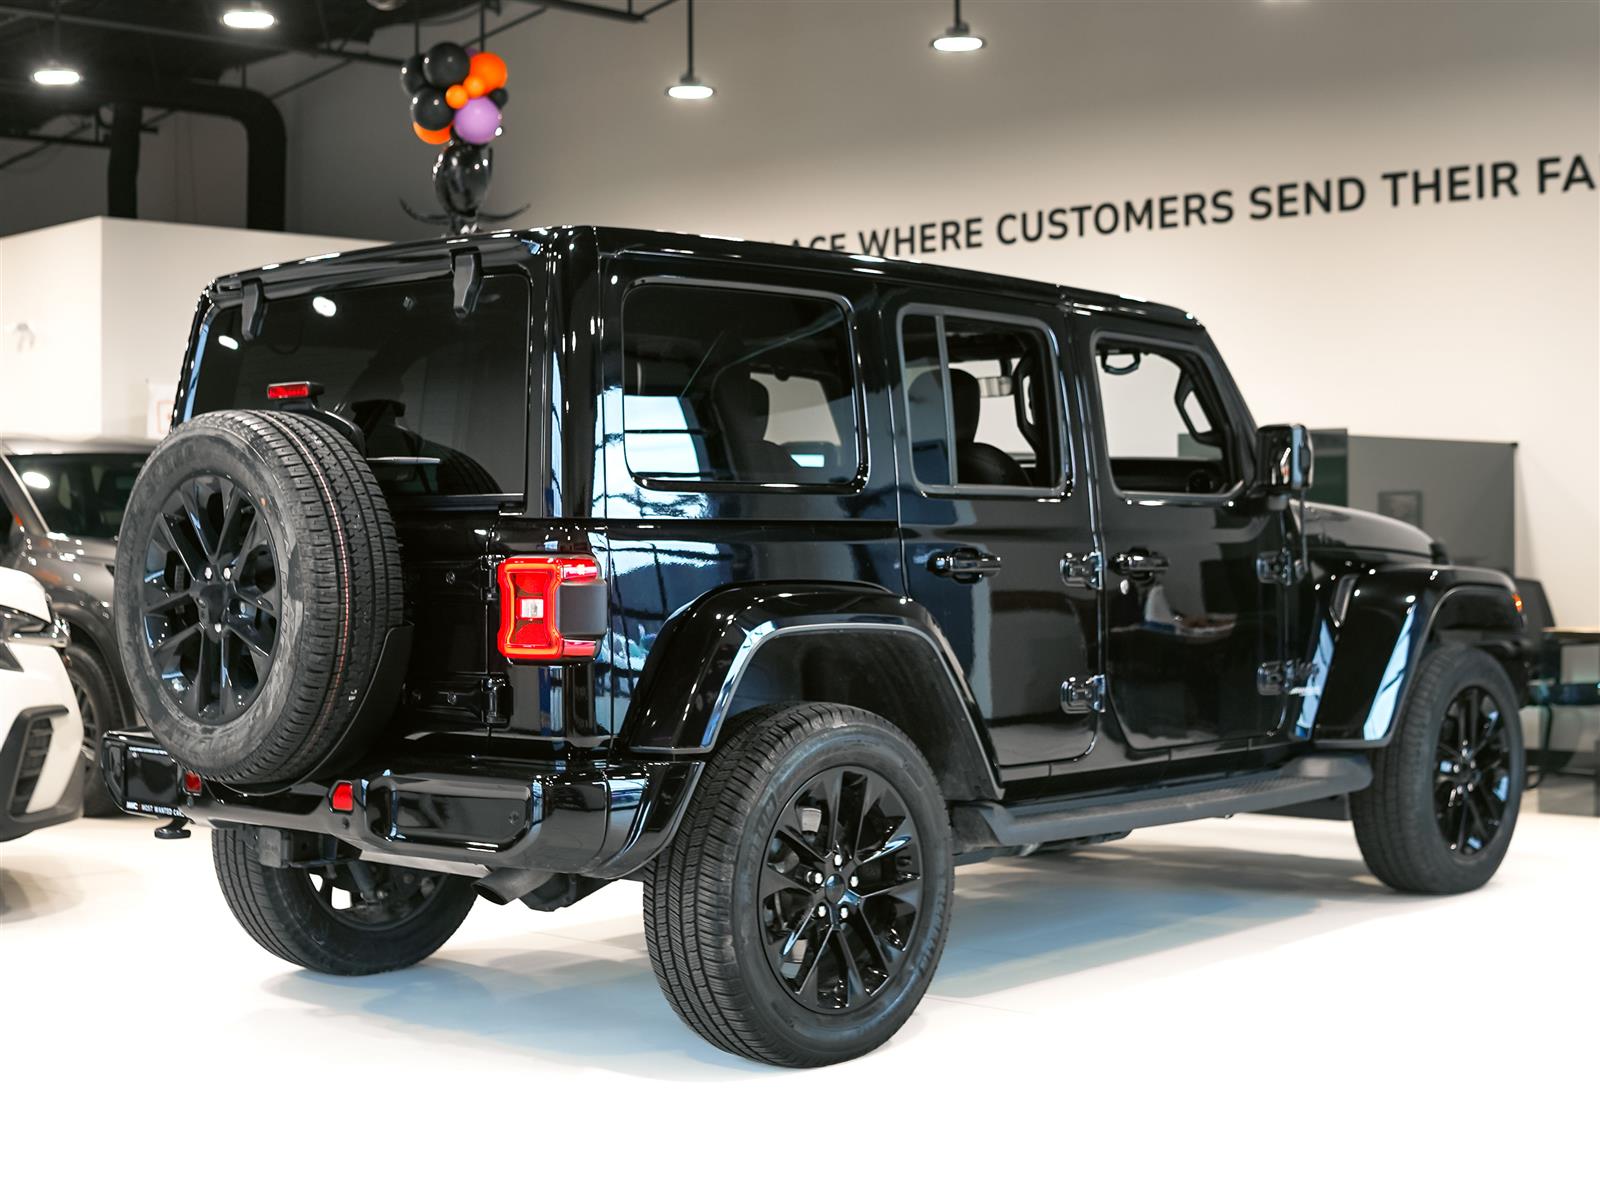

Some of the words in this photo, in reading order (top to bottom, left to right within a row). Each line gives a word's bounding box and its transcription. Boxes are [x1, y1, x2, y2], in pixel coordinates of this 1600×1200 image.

[858, 217, 984, 257] WHERE
[996, 189, 1234, 245] CUSTOMERS
[1249, 176, 1366, 221] SEND
[1380, 161, 1519, 207] THEIR
[1537, 154, 1597, 195] FA
